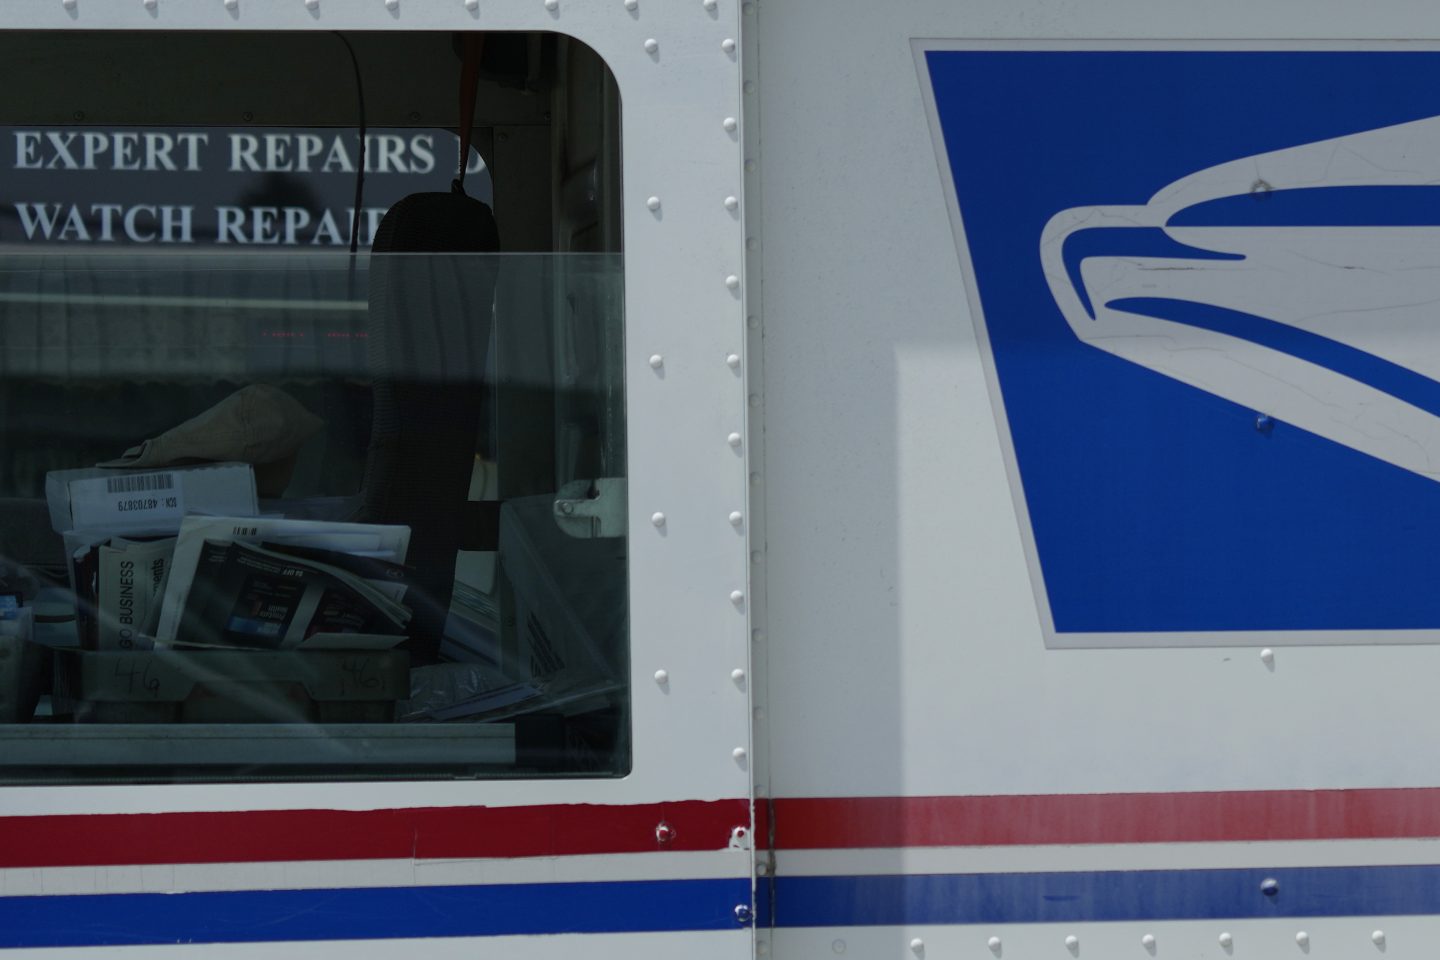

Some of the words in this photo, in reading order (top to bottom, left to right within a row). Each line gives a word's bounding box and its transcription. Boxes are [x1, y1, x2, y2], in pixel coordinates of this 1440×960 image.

[13, 131, 208, 171] EXPERT
[228, 133, 435, 173] REPAIRS
[15, 203, 194, 243] WATCH
[119, 560, 134, 625] BUSINESS
